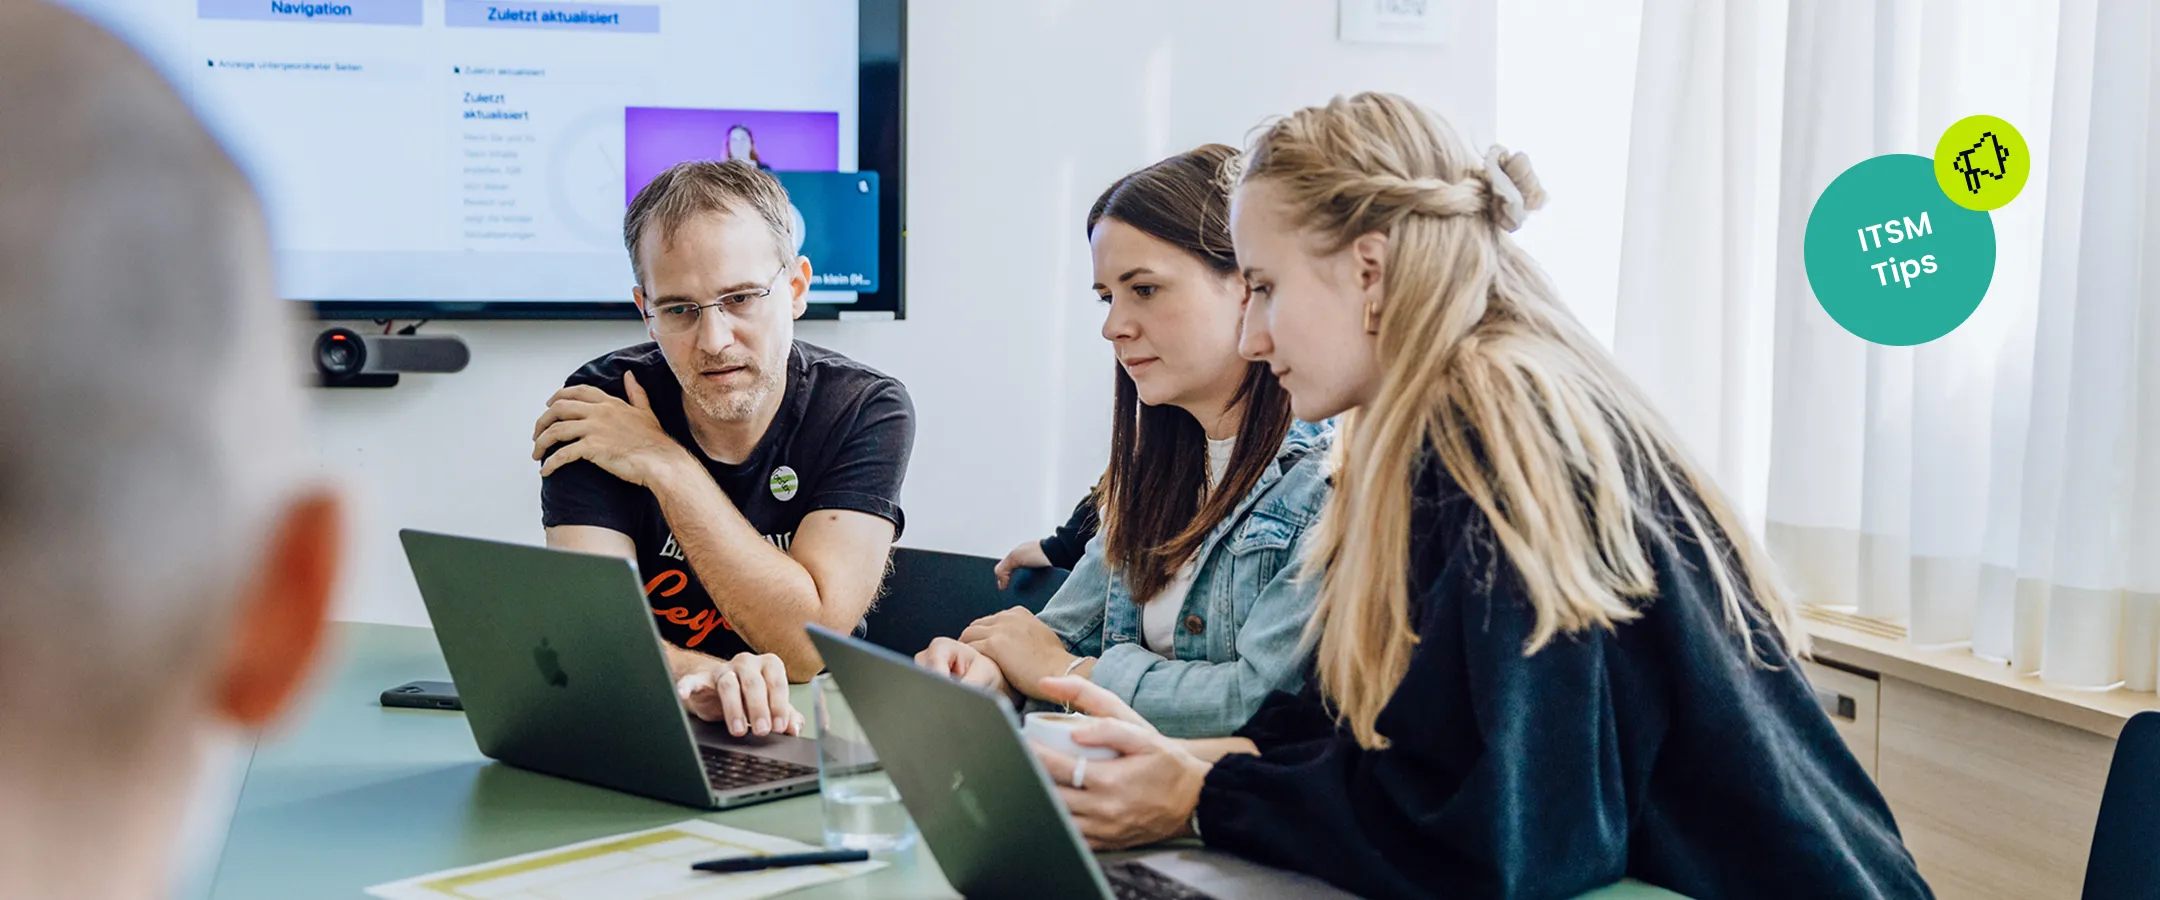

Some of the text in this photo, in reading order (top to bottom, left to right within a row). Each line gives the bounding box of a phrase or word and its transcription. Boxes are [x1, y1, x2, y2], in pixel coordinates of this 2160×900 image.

[271, 0, 352, 17] Navigation
[488, 7, 619, 24] Zuletzt aktualisiert
[463, 92, 505, 104] Zuletzt
[463, 109, 529, 120] aktualisiert
